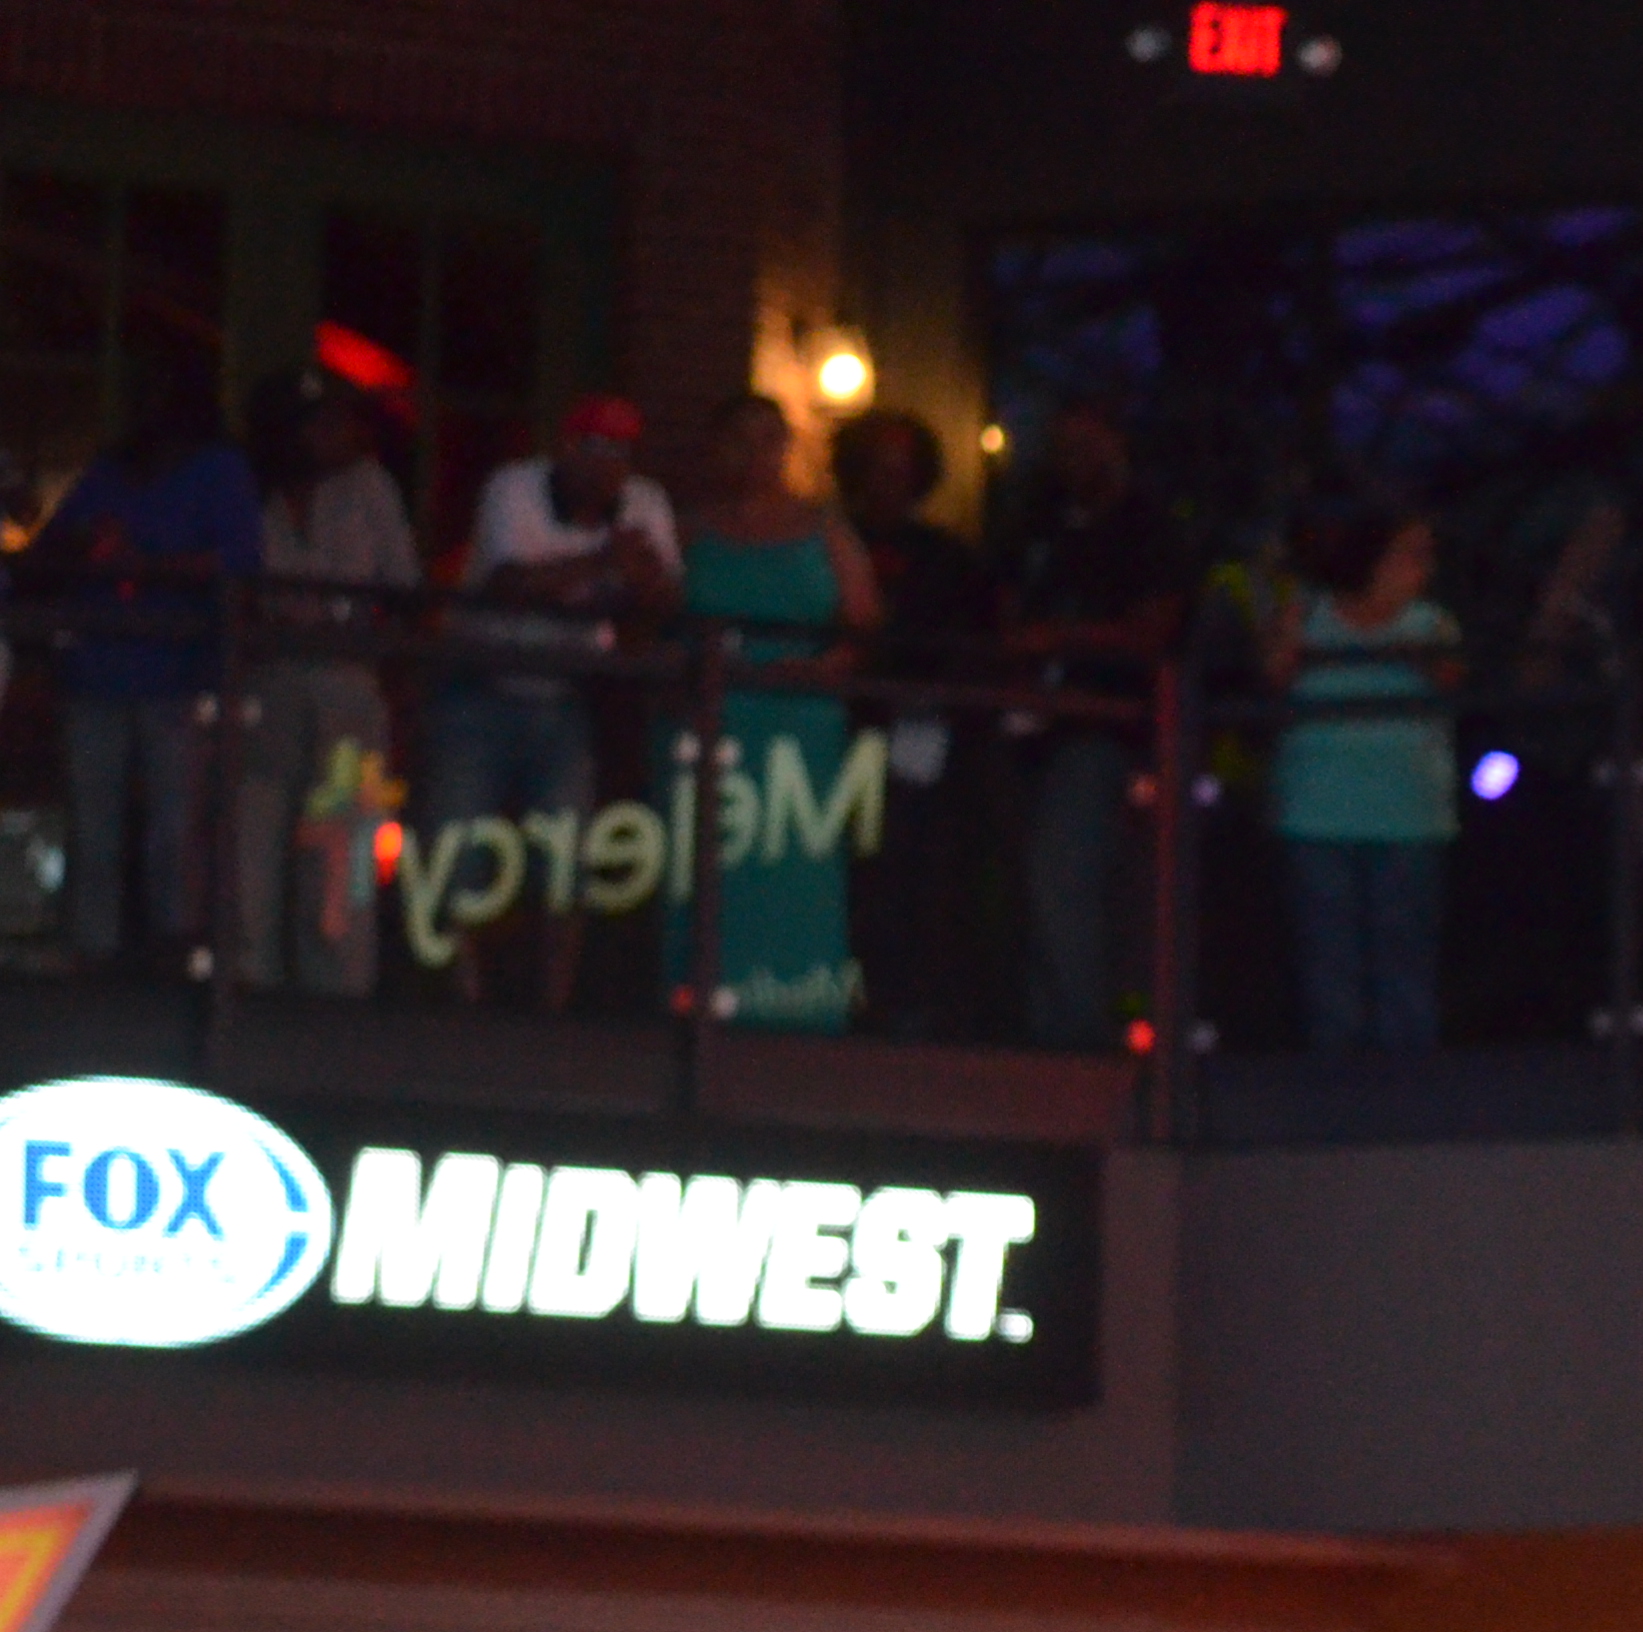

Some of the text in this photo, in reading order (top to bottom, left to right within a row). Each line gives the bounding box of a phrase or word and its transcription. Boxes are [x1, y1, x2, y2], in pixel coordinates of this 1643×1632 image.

[1191, 3, 1284, 75] EXIT
[22, 1139, 227, 1242] FOX
[17, 1242, 237, 1284] SPORTS
